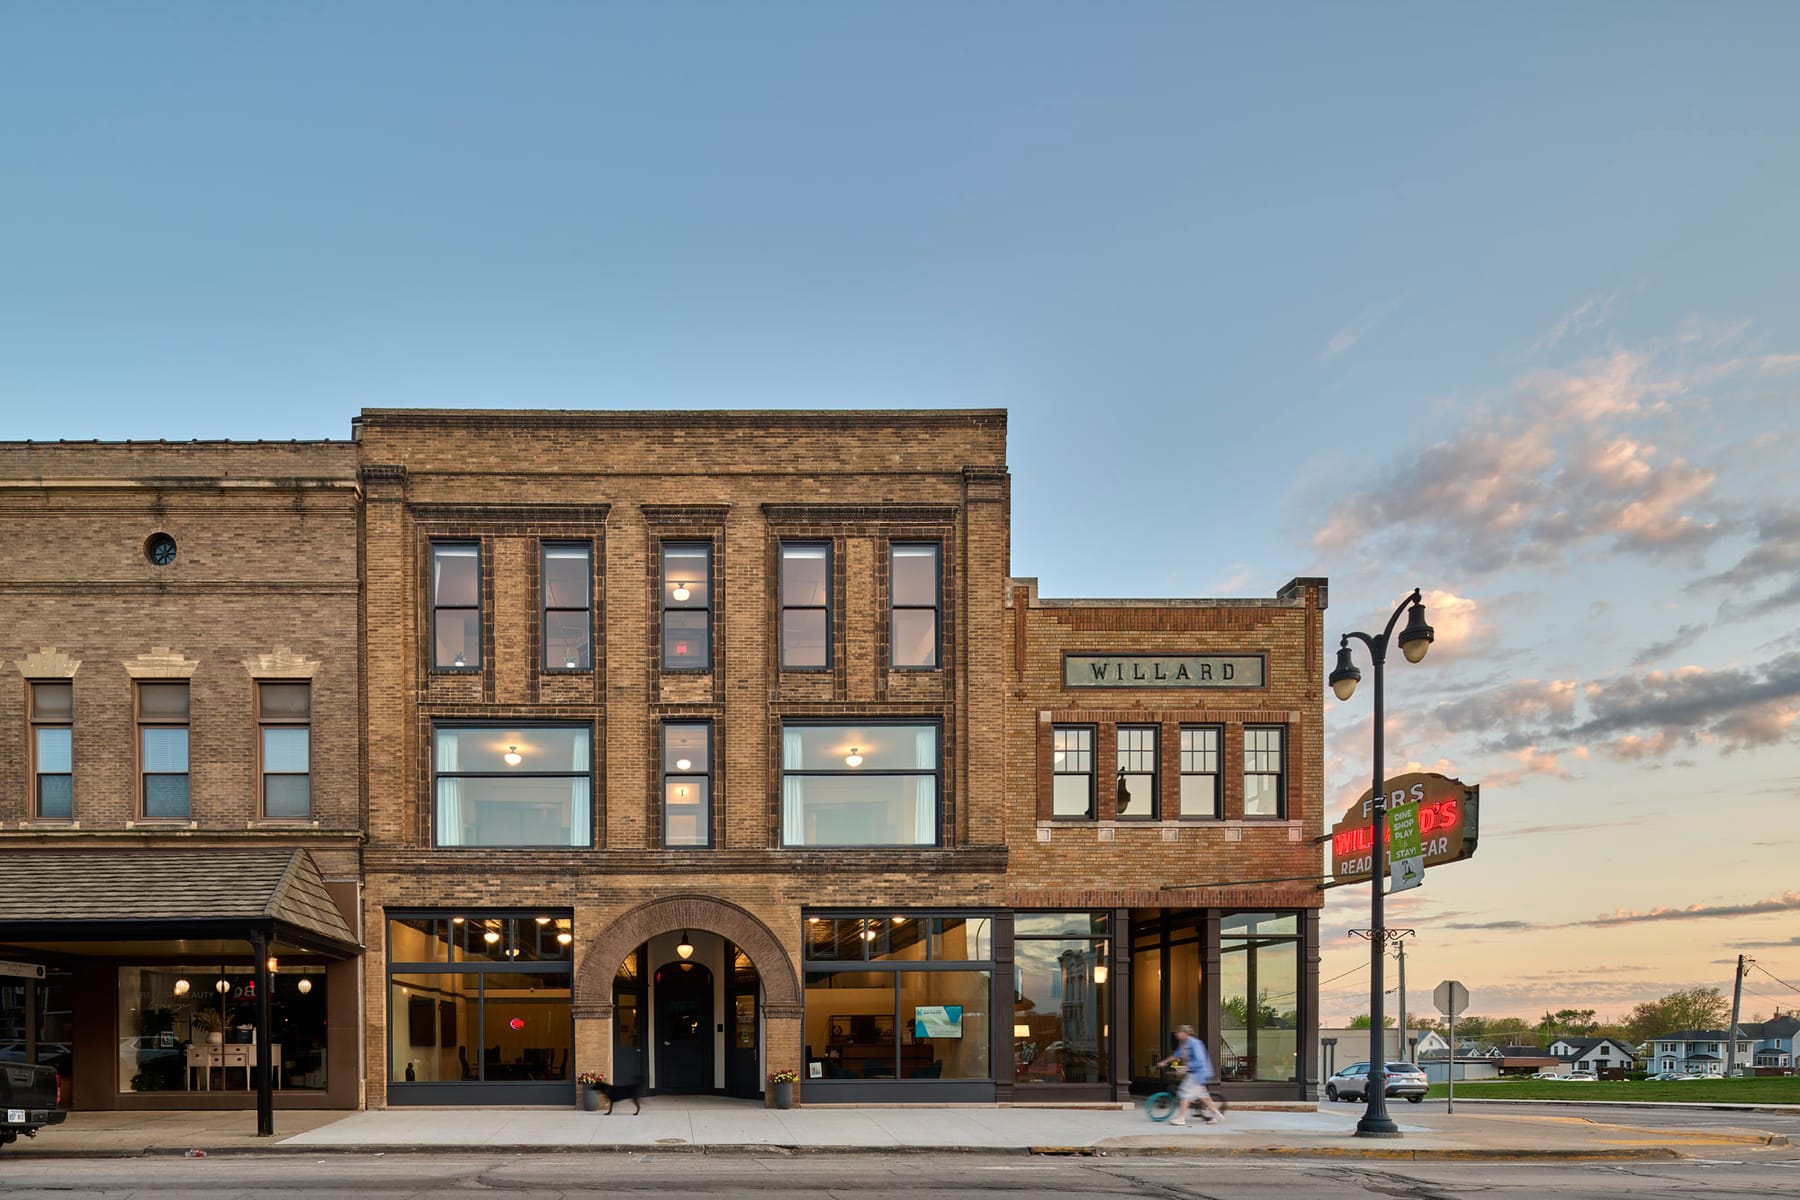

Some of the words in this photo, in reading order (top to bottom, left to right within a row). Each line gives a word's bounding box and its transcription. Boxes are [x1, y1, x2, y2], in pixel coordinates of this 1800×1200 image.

[1091, 663, 1235, 680] WILLARD
[1394, 810, 1412, 821] DINE
[1393, 819, 1414, 831] SHOP
[1394, 829, 1413, 840] PLAY
[1341, 855, 1372, 875] READ
[1421, 837, 1448, 857] EAR
[1395, 847, 1417, 859] STAY!
